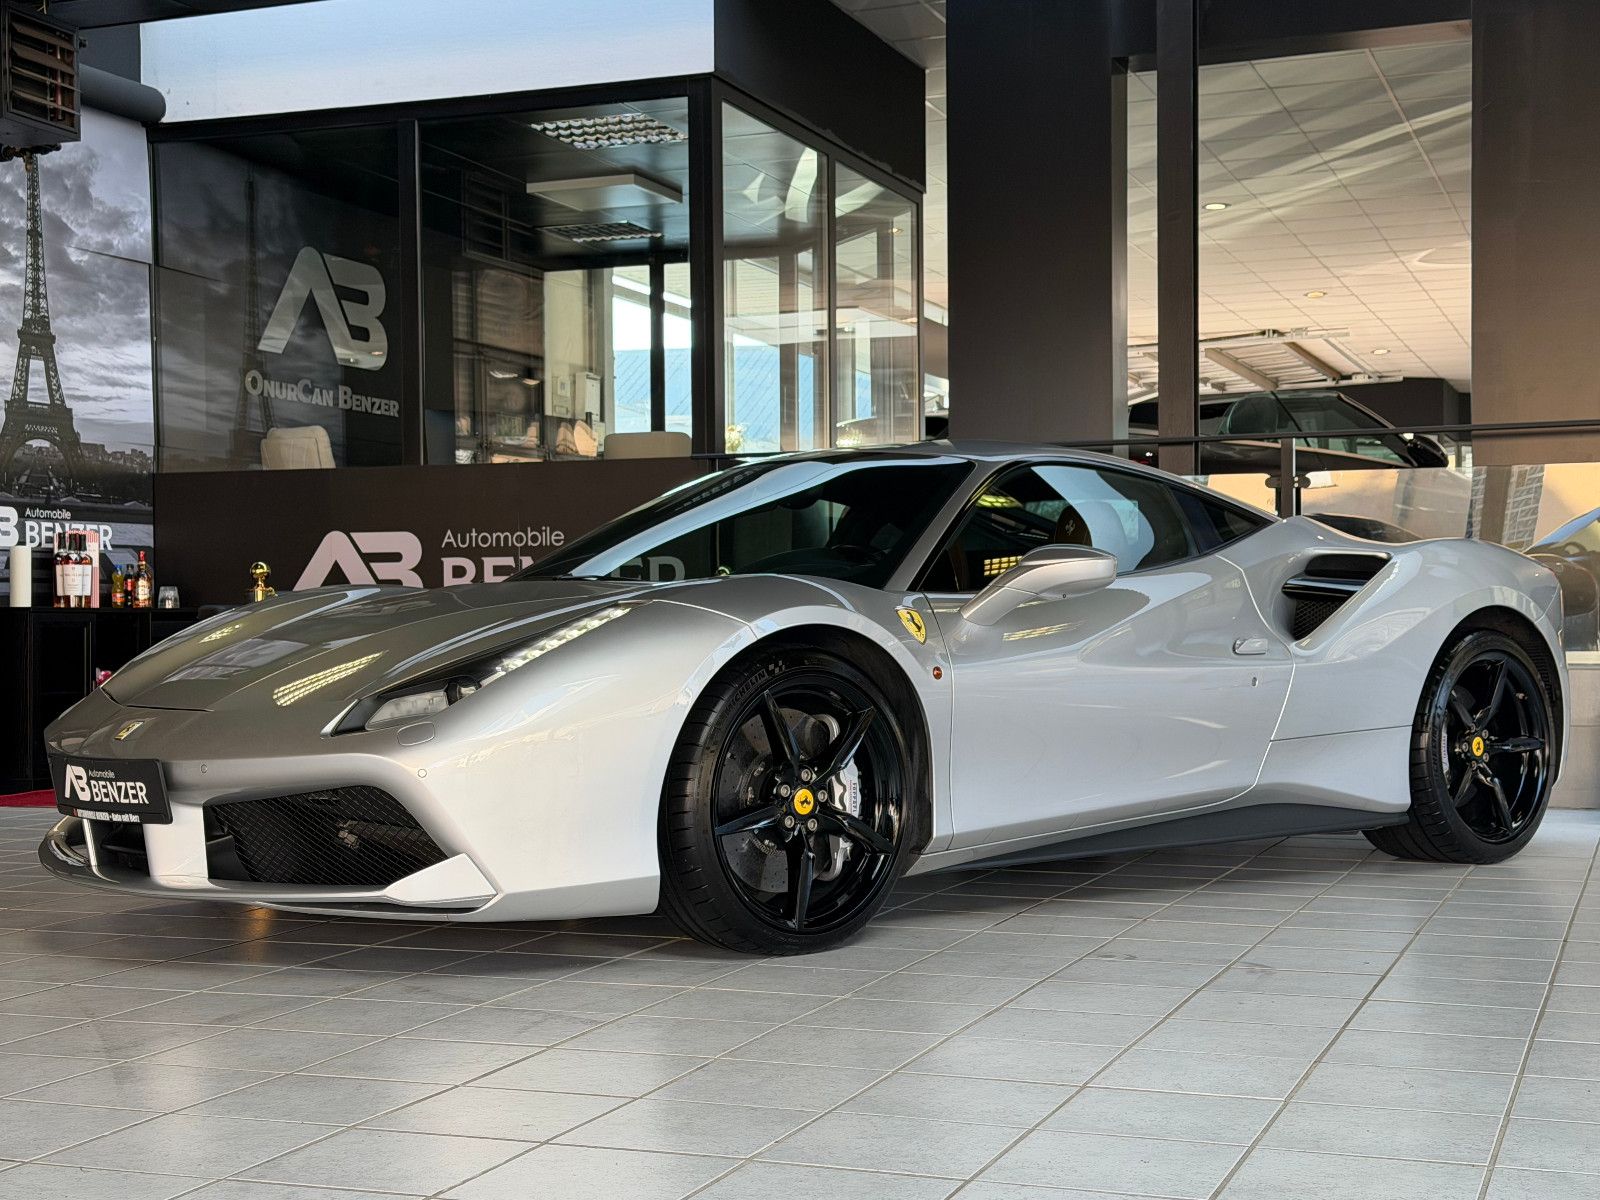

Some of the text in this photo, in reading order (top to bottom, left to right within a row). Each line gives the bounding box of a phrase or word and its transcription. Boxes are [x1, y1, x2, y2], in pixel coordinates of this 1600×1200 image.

[25, 507, 71, 519] Automobile
[441, 526, 565, 547] Automobile
[88, 769, 115, 779] Automobile
[90, 780, 149, 804] BENZER
